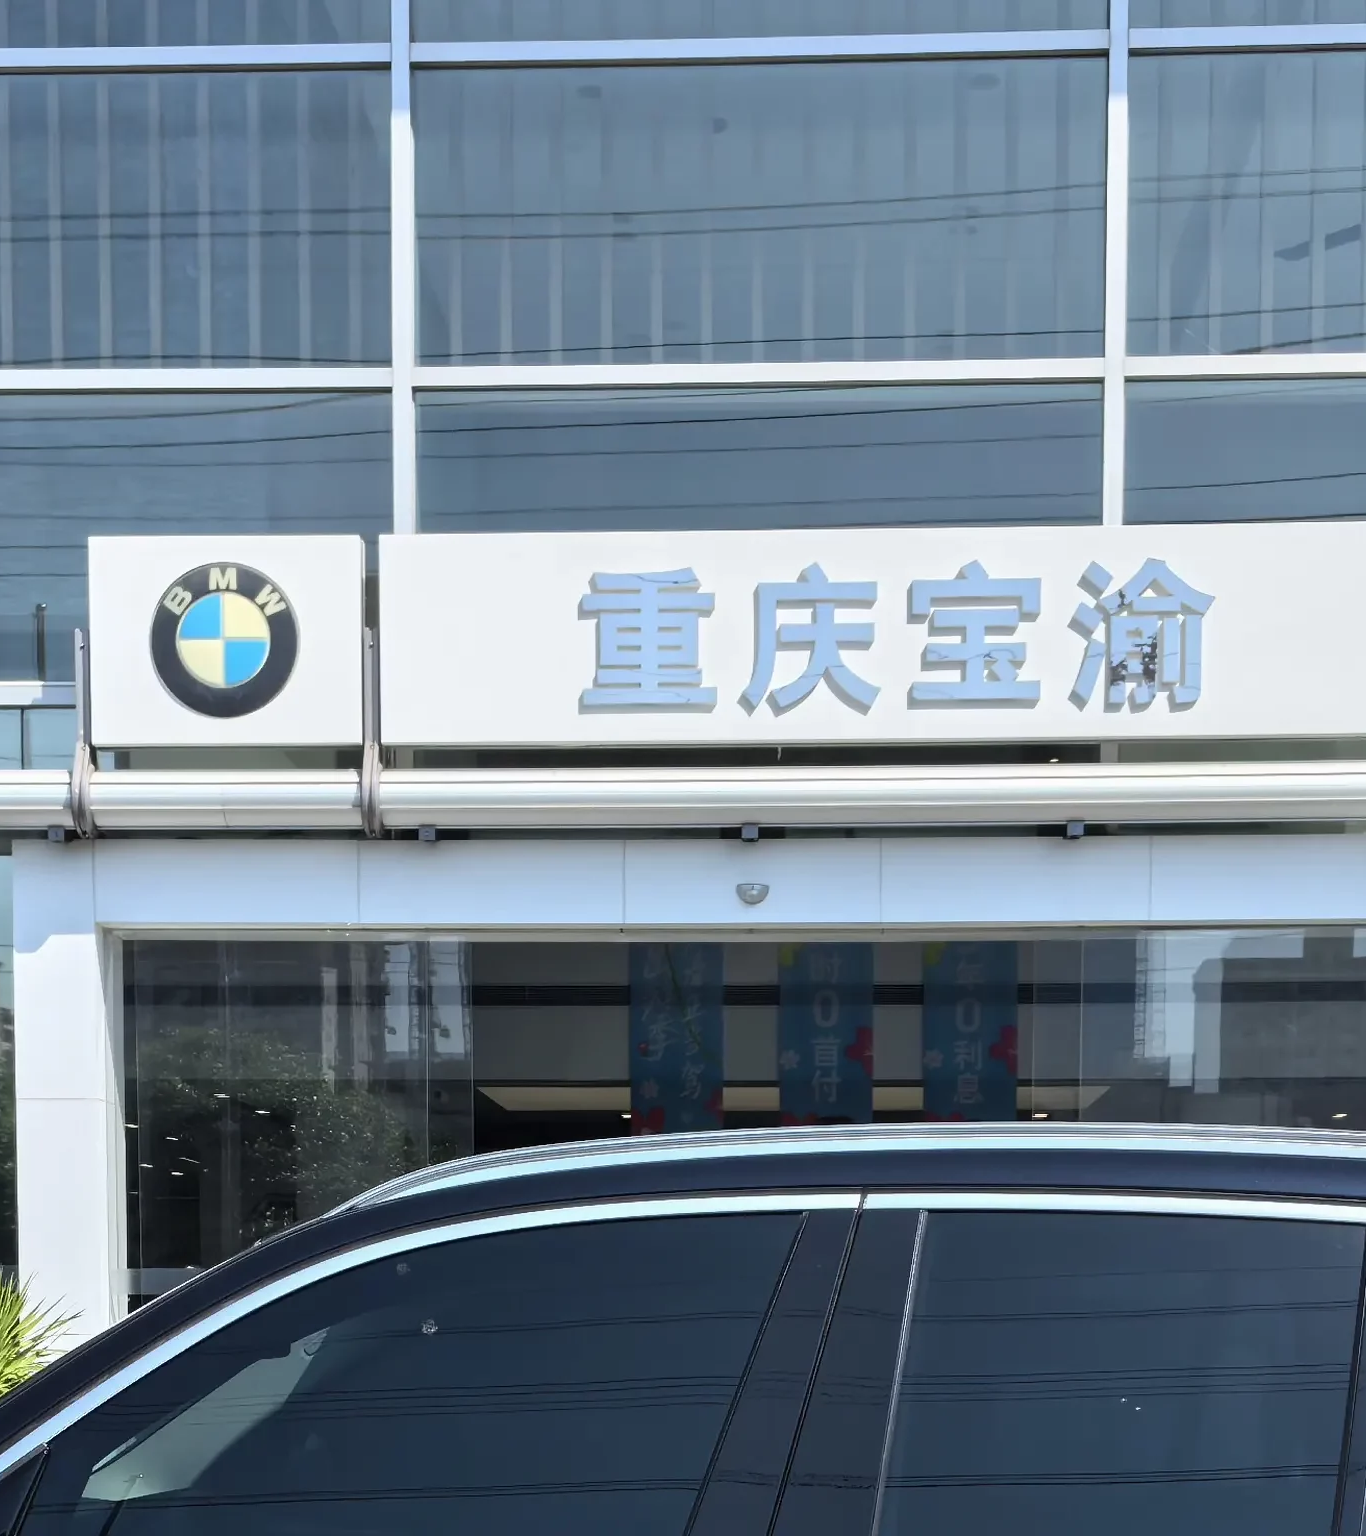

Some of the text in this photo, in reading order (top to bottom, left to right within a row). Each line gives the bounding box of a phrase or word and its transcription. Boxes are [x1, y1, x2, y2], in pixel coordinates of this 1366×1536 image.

[163, 566, 287, 617] BMW
[578, 558, 1217, 717] 重庆宝渝
[953, 944, 985, 1104] 年0利息
